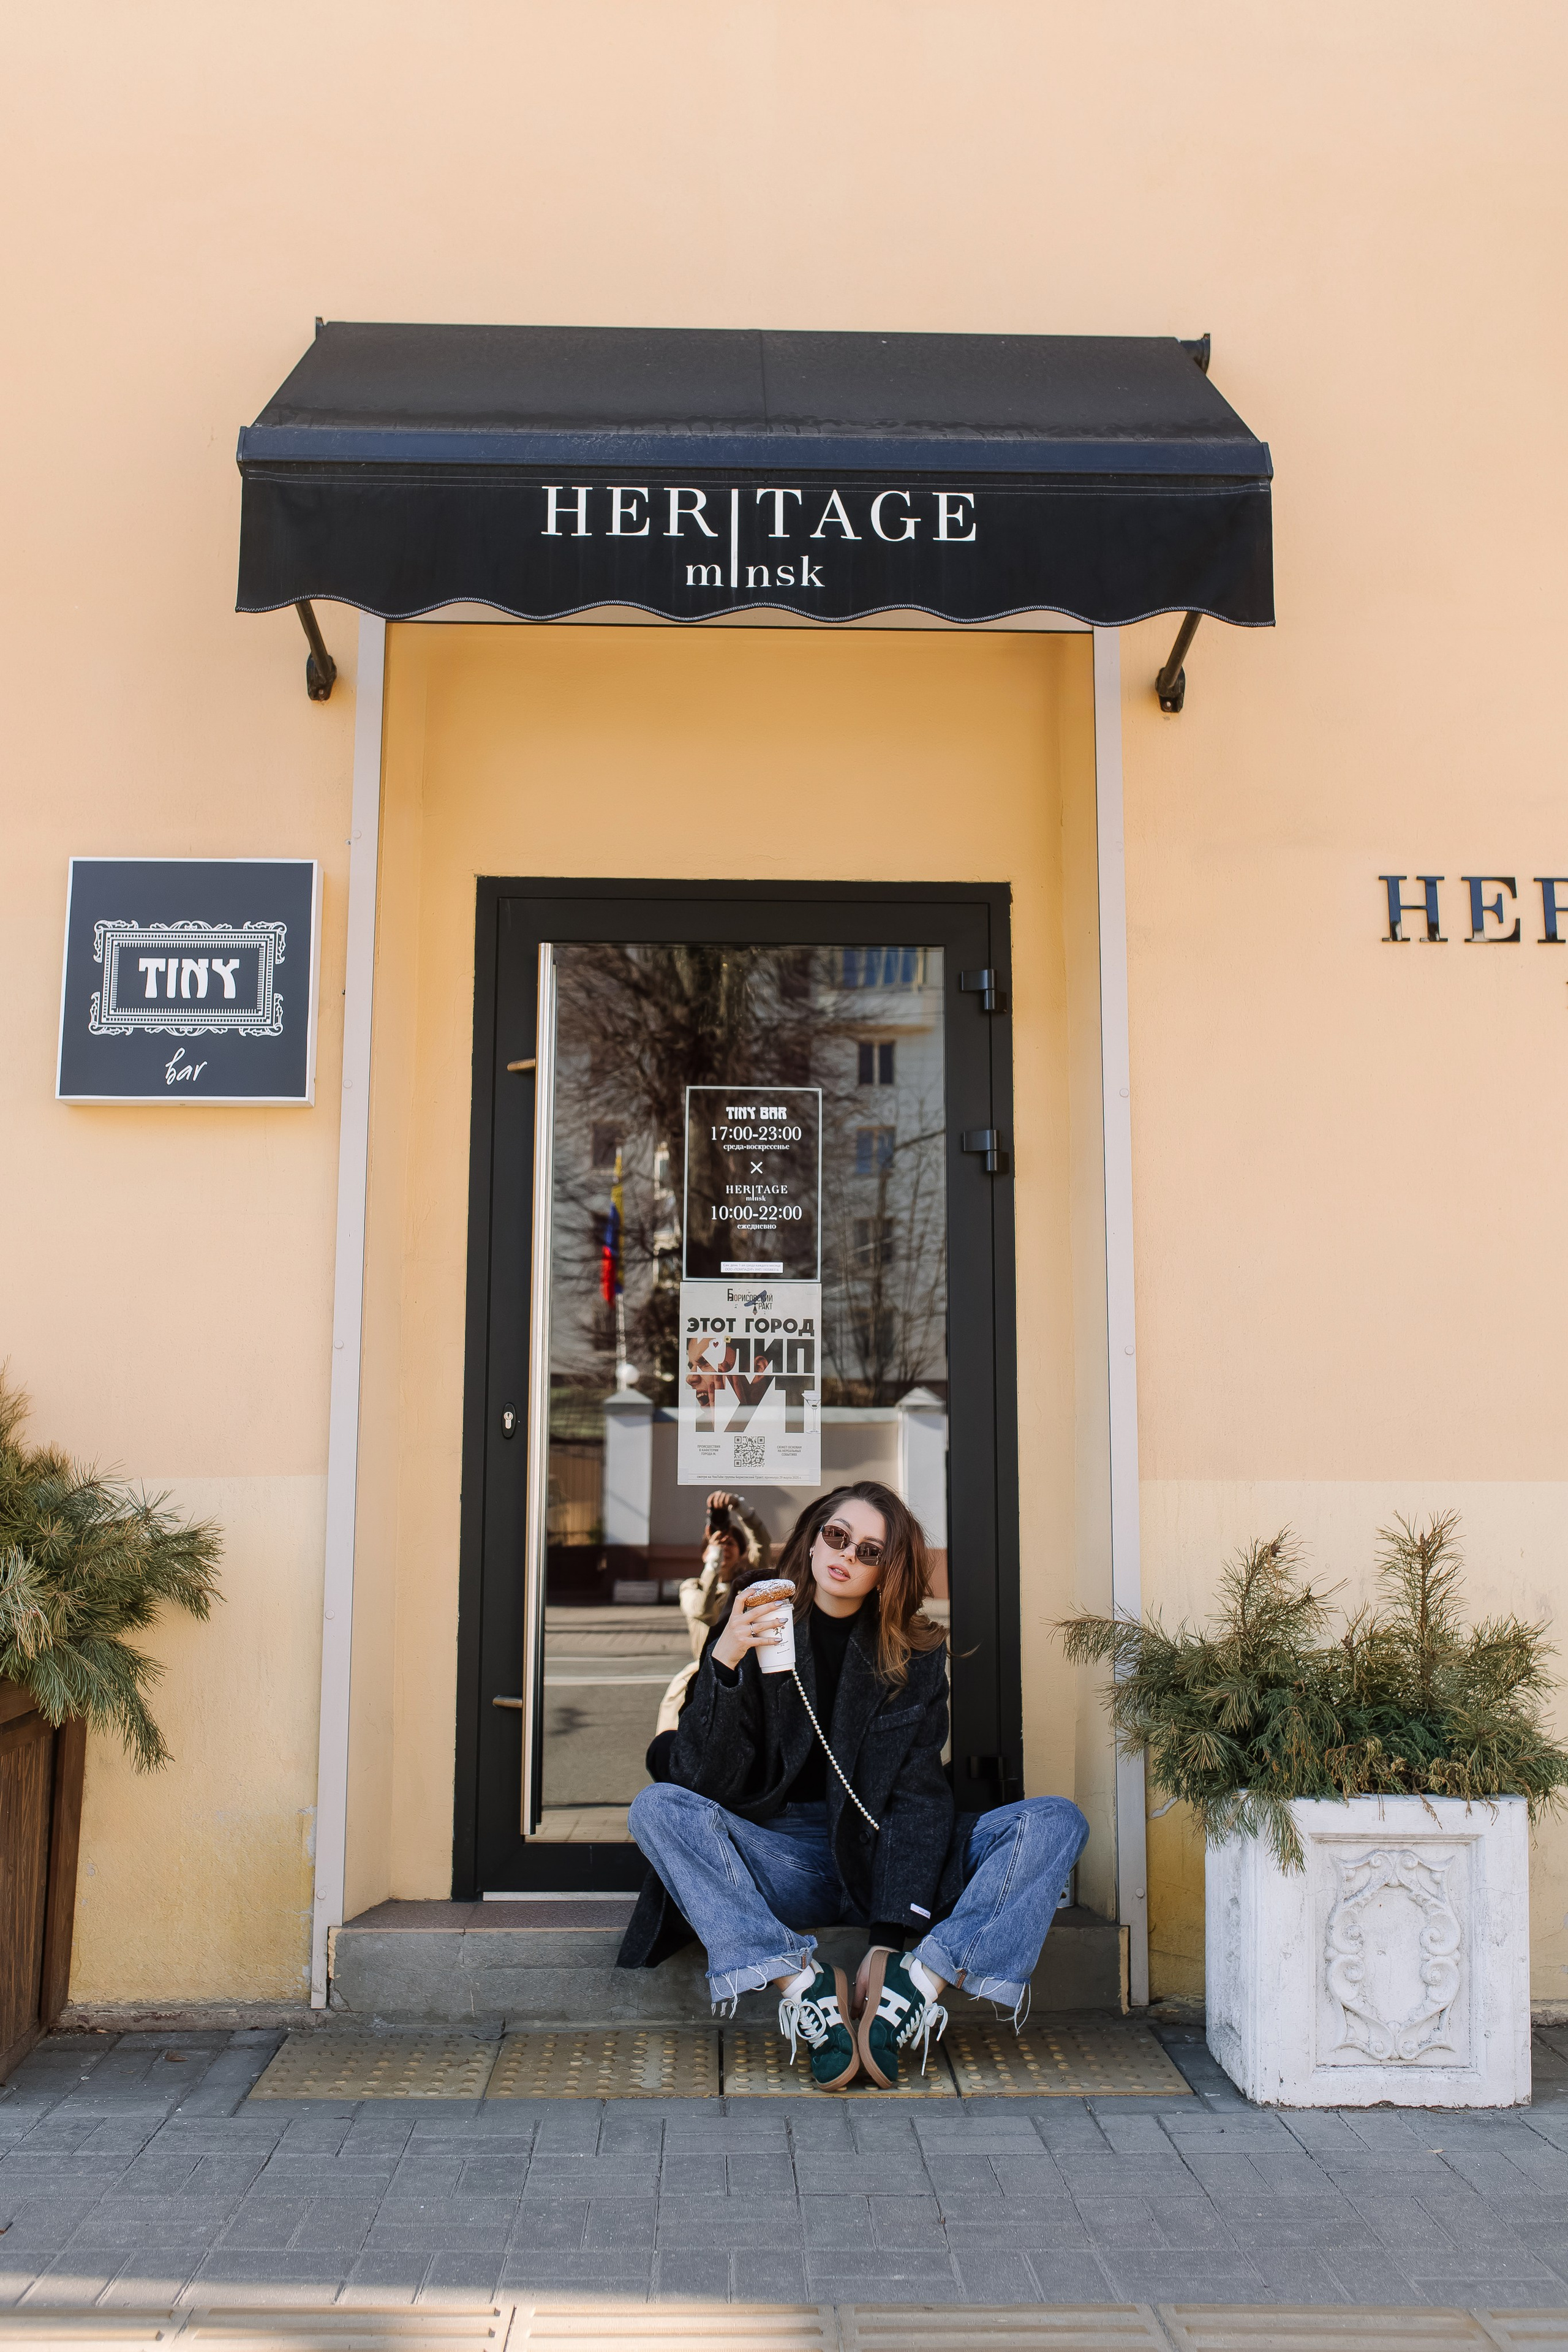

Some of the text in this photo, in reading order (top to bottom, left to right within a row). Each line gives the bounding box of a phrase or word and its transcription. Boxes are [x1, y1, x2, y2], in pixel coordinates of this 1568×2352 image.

[541, 486, 977, 542] HERITAGE
[138, 957, 240, 999] TINY
[165, 1047, 208, 1085] bar
[726, 1107, 787, 1120] TINY BAR
[711, 1126, 802, 1140] 17:00-23:00
[726, 1185, 788, 1194] HERITAGE
[711, 1205, 802, 1221] 10:00-22:00
[687, 1317, 815, 1336] ЭТОТ ГОРОД
[686, 1337, 815, 1373] КЛИП
[685, 1374, 815, 1433] ТУТ
